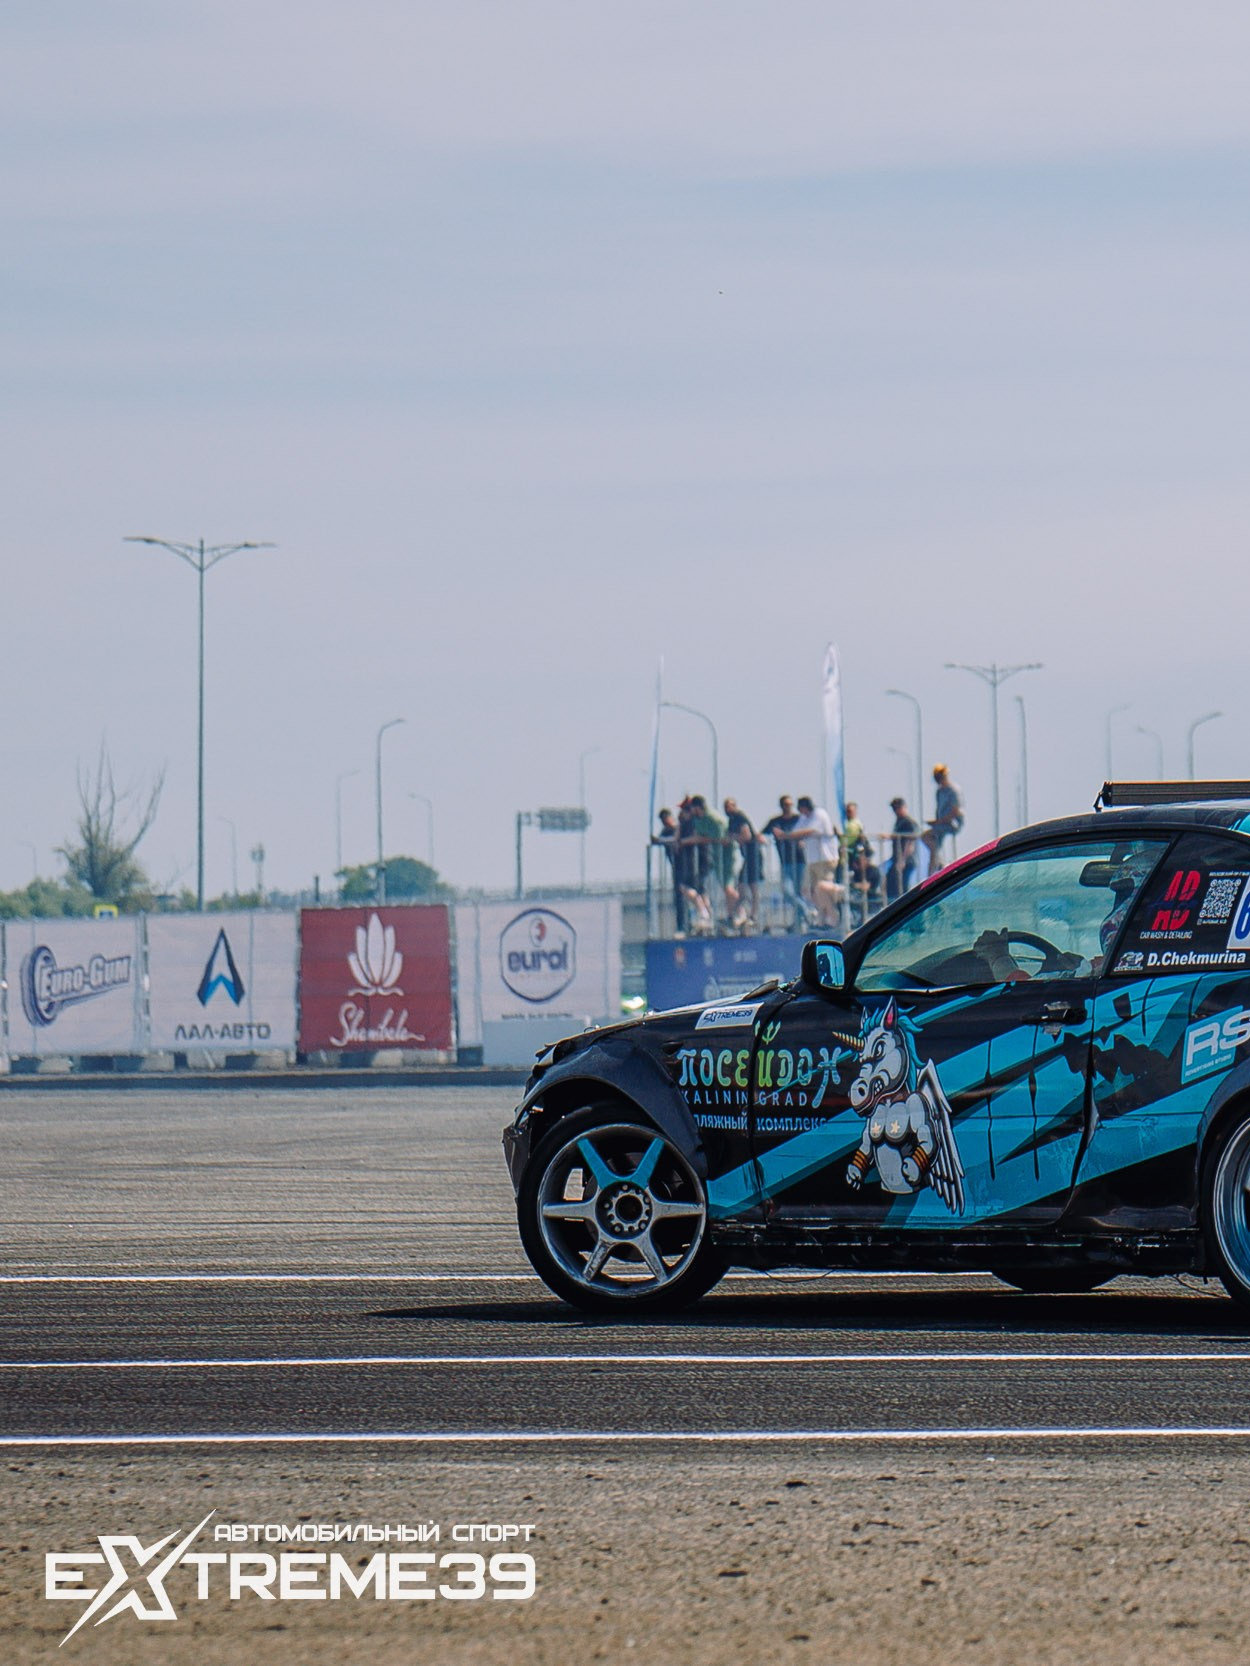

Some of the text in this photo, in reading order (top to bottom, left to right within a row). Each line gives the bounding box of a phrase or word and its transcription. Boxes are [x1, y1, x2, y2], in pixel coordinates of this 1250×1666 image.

[1140, 931, 1150, 939] CAR
[1150, 931, 1164, 939] WASH
[1169, 931, 1193, 939] DETAILING
[508, 941, 568, 972] eurol
[1147, 950, 1246, 966] D.Chekmurina
